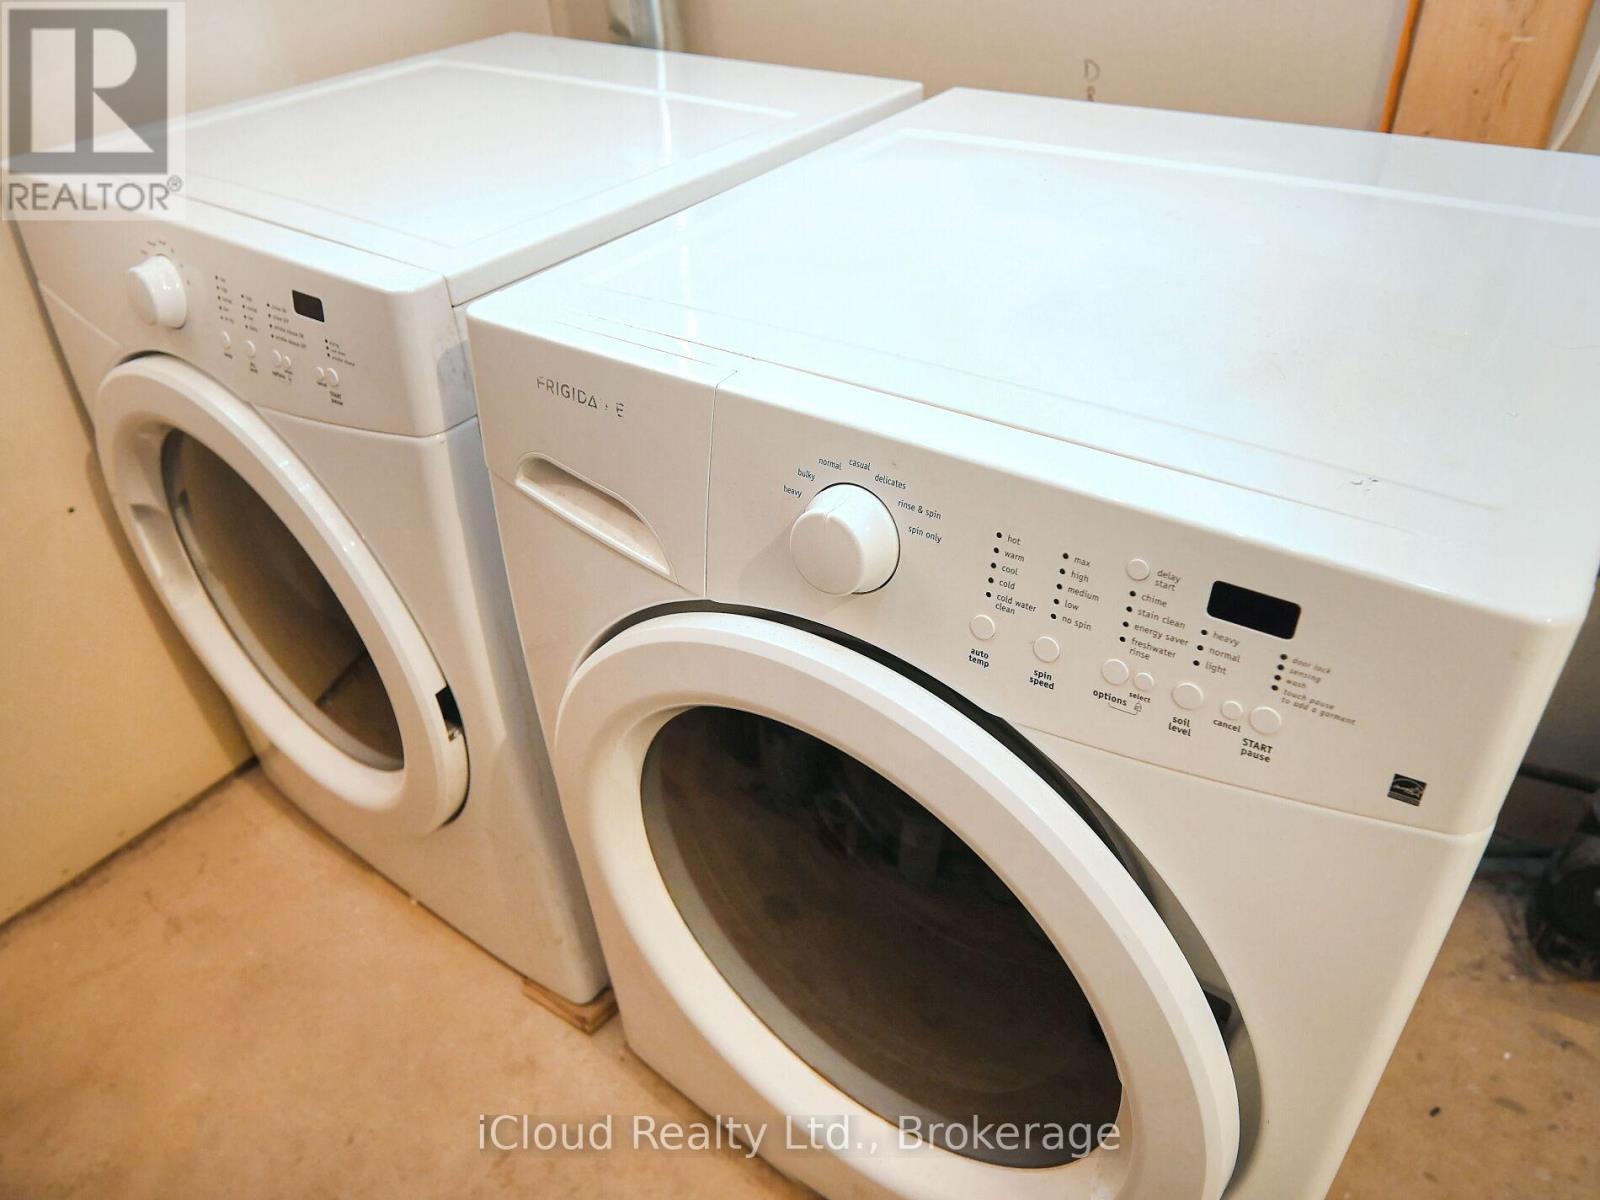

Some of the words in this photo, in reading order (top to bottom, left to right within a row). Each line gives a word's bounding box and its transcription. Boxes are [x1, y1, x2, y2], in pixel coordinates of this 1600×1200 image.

[536, 375, 625, 418] FRIGIDAE
[818, 457, 842, 471] normal
[849, 458, 871, 471] casual
[797, 468, 816, 481] bulky
[874, 474, 907, 490] delicates
[783, 484, 802, 498] heavy
[897, 499, 916, 512] rinse
[917, 505, 923, 514] &
[925, 509, 942, 520] spin
[908, 525, 924, 537] spin
[925, 532, 942, 544] only
[1007, 534, 1021, 546] hot
[1004, 551, 1025, 562] warm
[1074, 556, 1091, 568] max
[1001, 564, 1018, 576] cool
[1071, 570, 1089, 583] high
[1157, 569, 1181, 584] delay
[999, 579, 1016, 590] cold
[1155, 579, 1176, 592] start
[1068, 586, 1100, 602] medium
[1141, 593, 1168, 608] chime
[995, 603, 1015, 615] clean
[996, 593, 1013, 605] cold
[1015, 600, 1037, 613] water
[1064, 600, 1080, 611] low
[1062, 615, 1073, 625] no
[1074, 619, 1092, 631] spin
[1137, 608, 1160, 622] stain
[1162, 615, 1186, 630] clean
[1134, 624, 1163, 640] energy
[1165, 633, 1189, 647] saver
[1213, 631, 1240, 647] heavy
[970, 647, 989, 659] auto
[1129, 648, 1151, 661] rinse
[1131, 637, 1177, 659] freshwater
[1209, 647, 1241, 663] normal
[968, 654, 990, 668] temp
[1033, 669, 1052, 681] spin
[1205, 661, 1227, 676] light
[1029, 676, 1055, 690] speed
[1093, 689, 1127, 707] options
[1129, 691, 1151, 704] select
[1172, 715, 1191, 728] soil
[1213, 718, 1241, 733] cancel
[1168, 722, 1192, 737] level
[1242, 737, 1273, 754] START
[1240, 747, 1271, 763] pause
